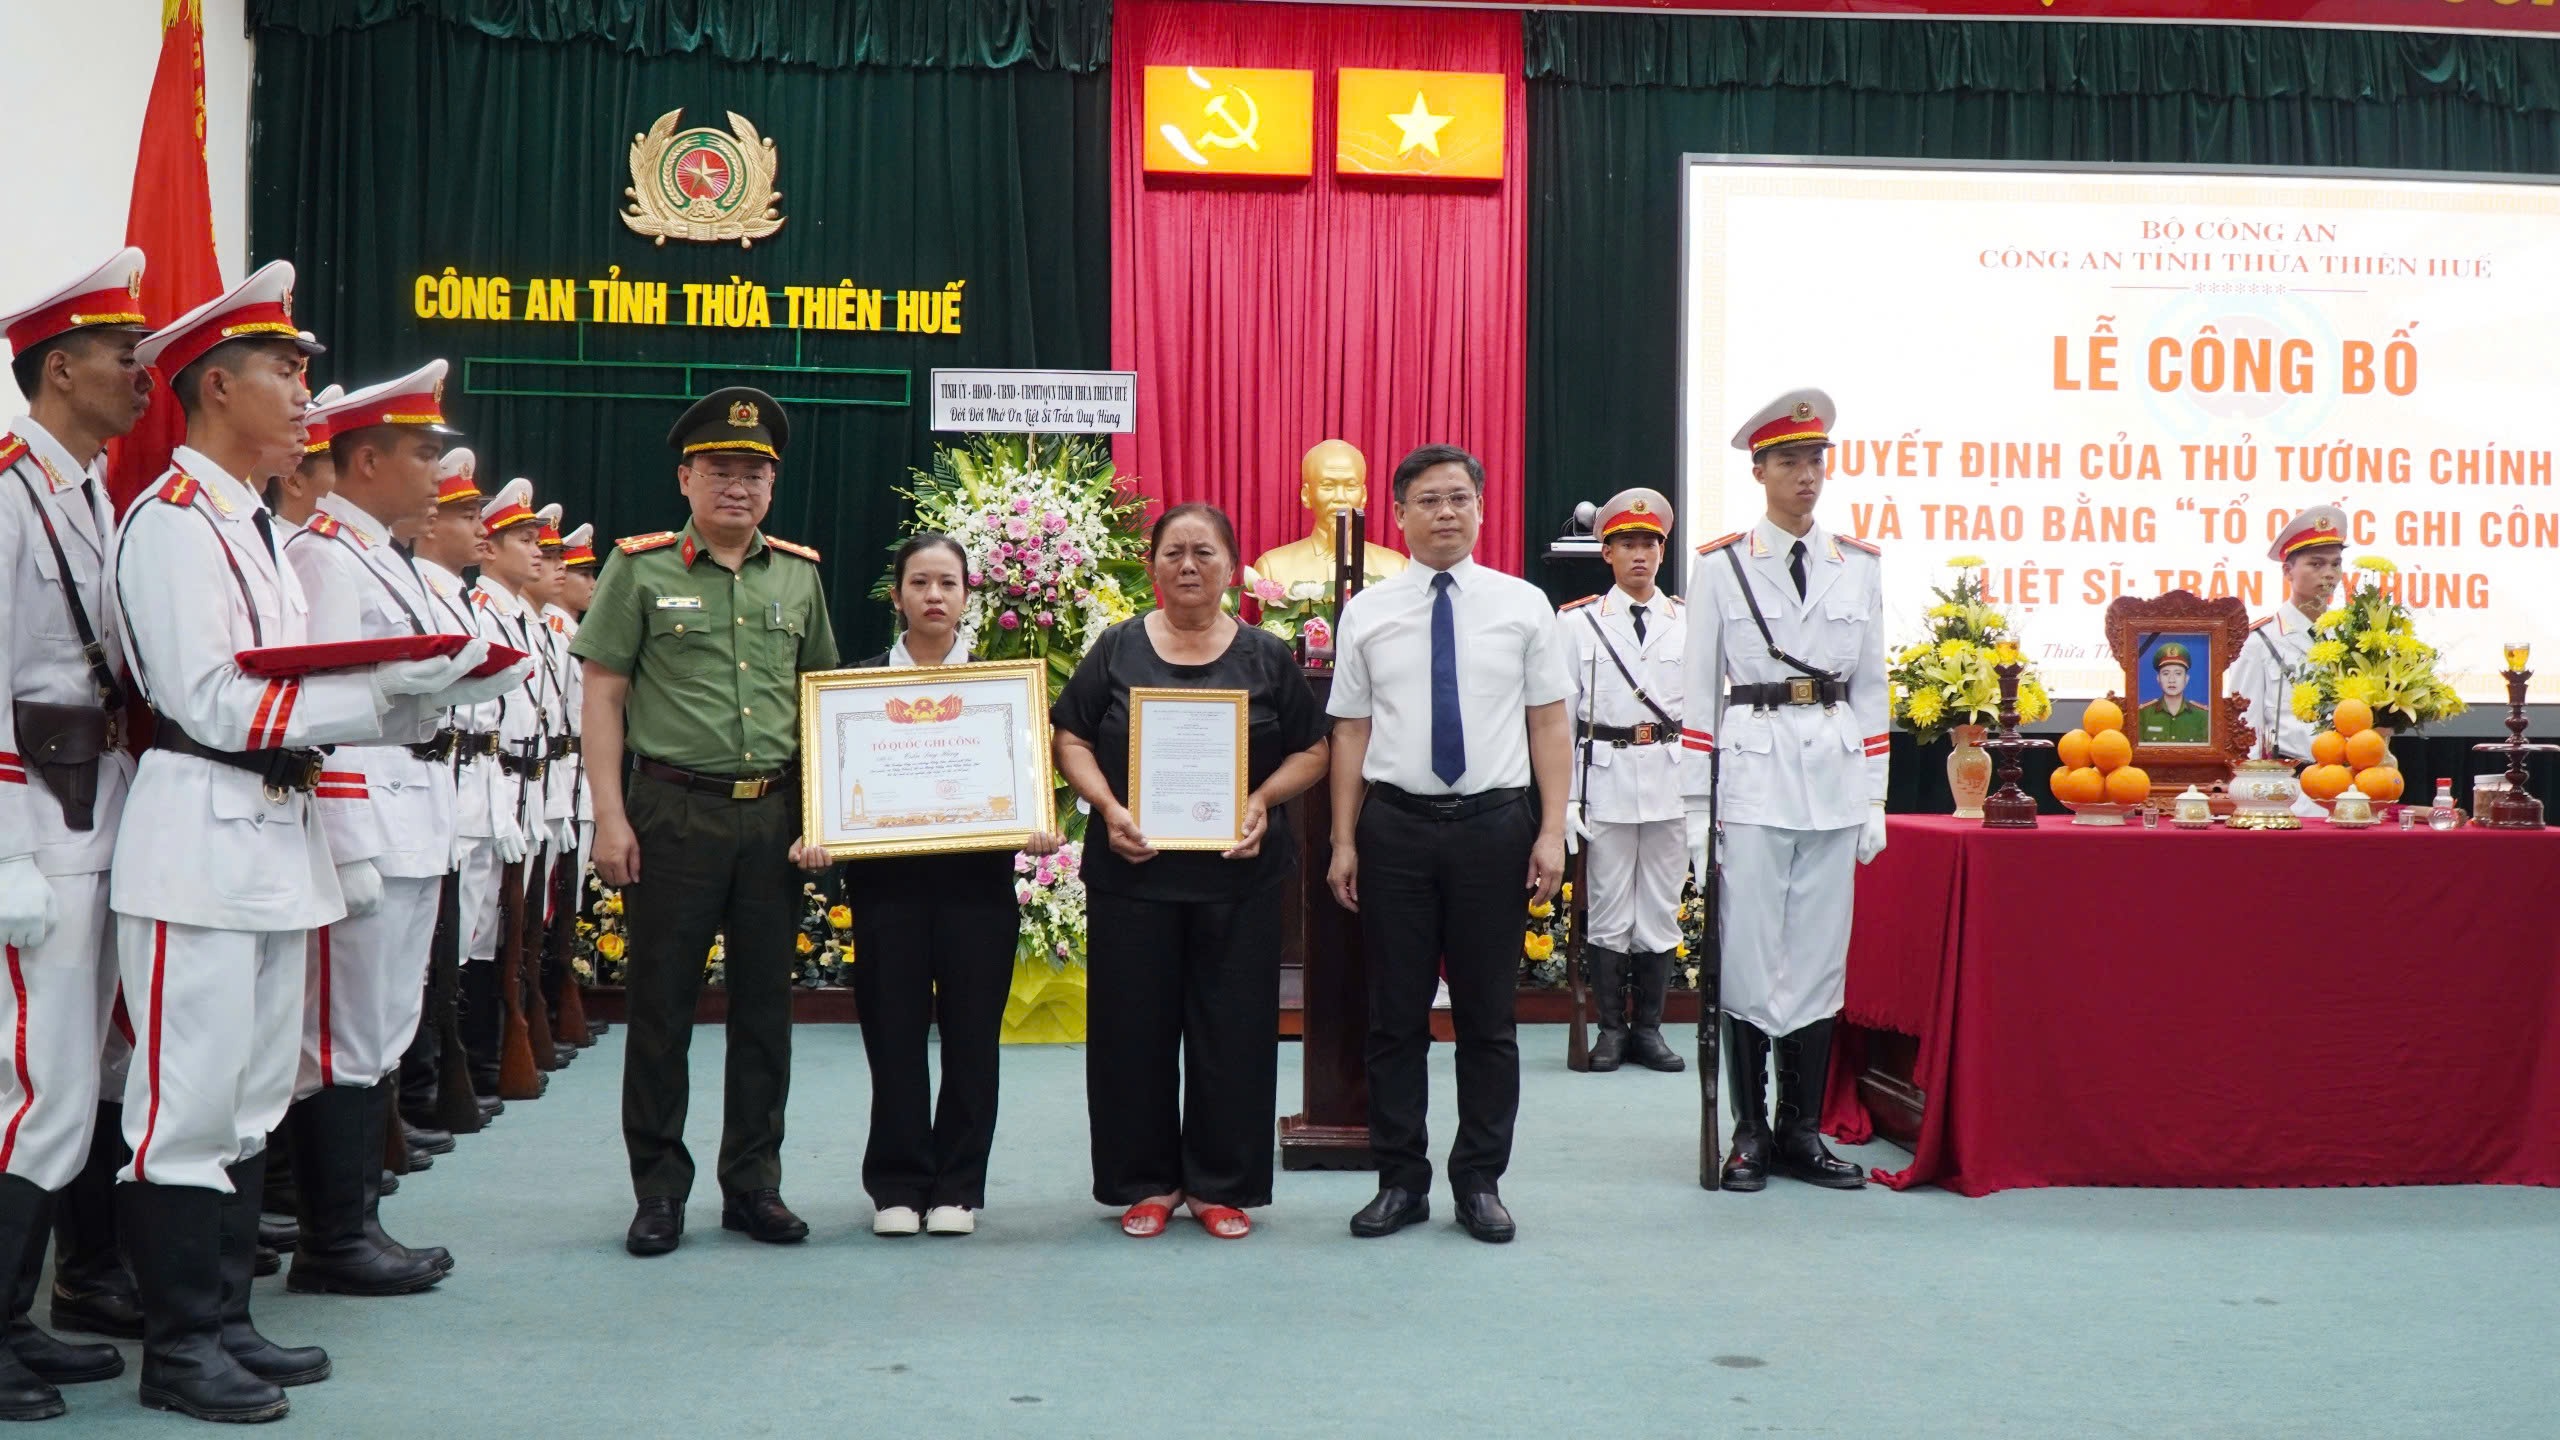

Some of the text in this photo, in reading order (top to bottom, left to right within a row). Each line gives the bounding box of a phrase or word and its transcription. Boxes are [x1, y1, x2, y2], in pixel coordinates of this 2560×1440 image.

[2142, 216, 2337, 245] BỘ CÔNG AN
[1978, 245, 2492, 278] CÔNG AN TỈNH THỪA THIÊN HUẾ
[415, 265, 966, 334] CÔNG AN TỈNH THỪA THIÊN HUẾ
[2053, 314, 2420, 396] LỄ CÔNG BỐ
[1960, 441, 2061, 487] ĐỊNH
[2079, 431, 2162, 480] CỦA
[2180, 432, 2257, 482] THỦ
[2275, 438, 2411, 484] TƯỚNG
[2430, 442, 2552, 486] CHÍNH
[1850, 495, 1902, 540] VÀ
[1920, 504, 2023, 541] TRAO
[2042, 492, 2156, 544] BẰNG
[2396, 509, 2461, 547] GHI
[1980, 560, 2066, 612] LIỆT
[2154, 557, 2263, 606] TRẦN
[2379, 565, 2489, 609] HÙNG
